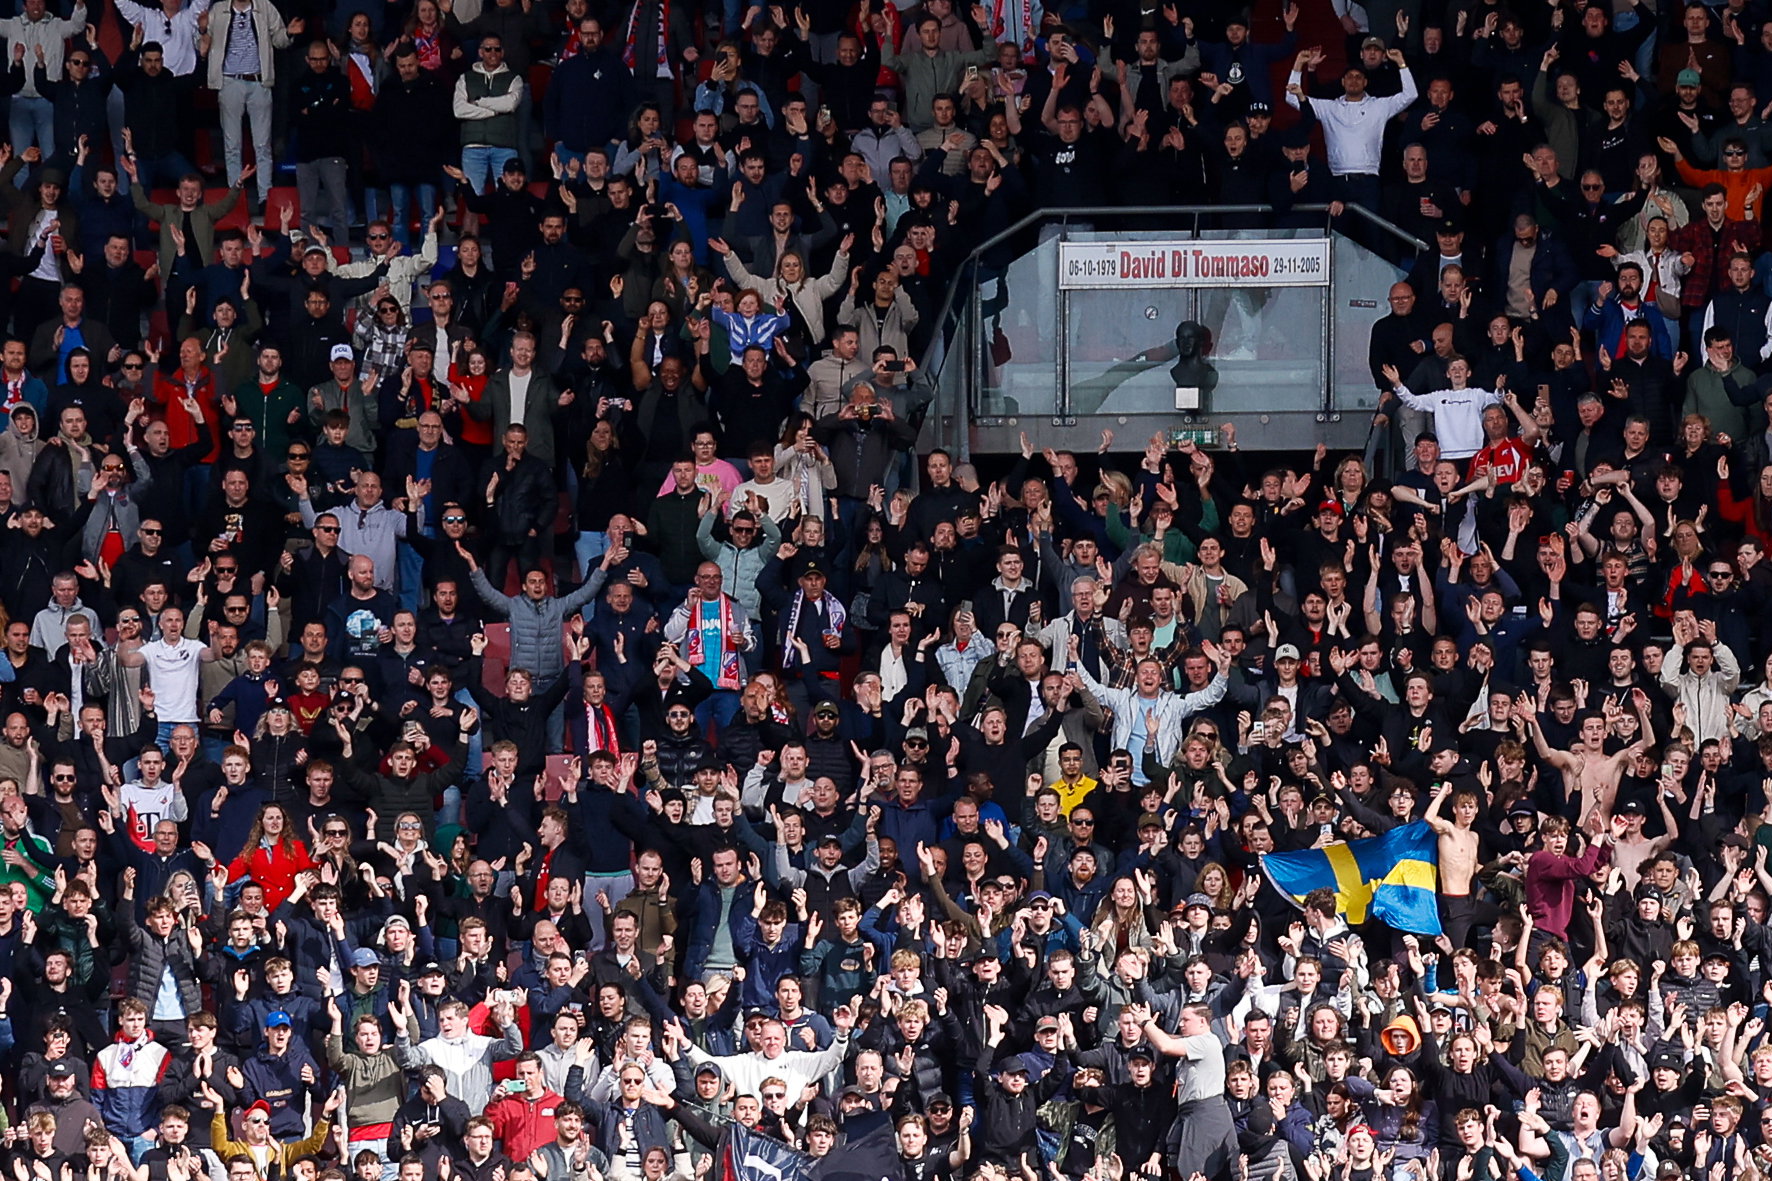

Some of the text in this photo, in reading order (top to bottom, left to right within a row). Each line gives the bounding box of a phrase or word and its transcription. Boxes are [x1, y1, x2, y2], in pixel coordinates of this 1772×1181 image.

[1069, 249, 1321, 280] 06-10-1979 David Di Tommaso 29-11-2005
